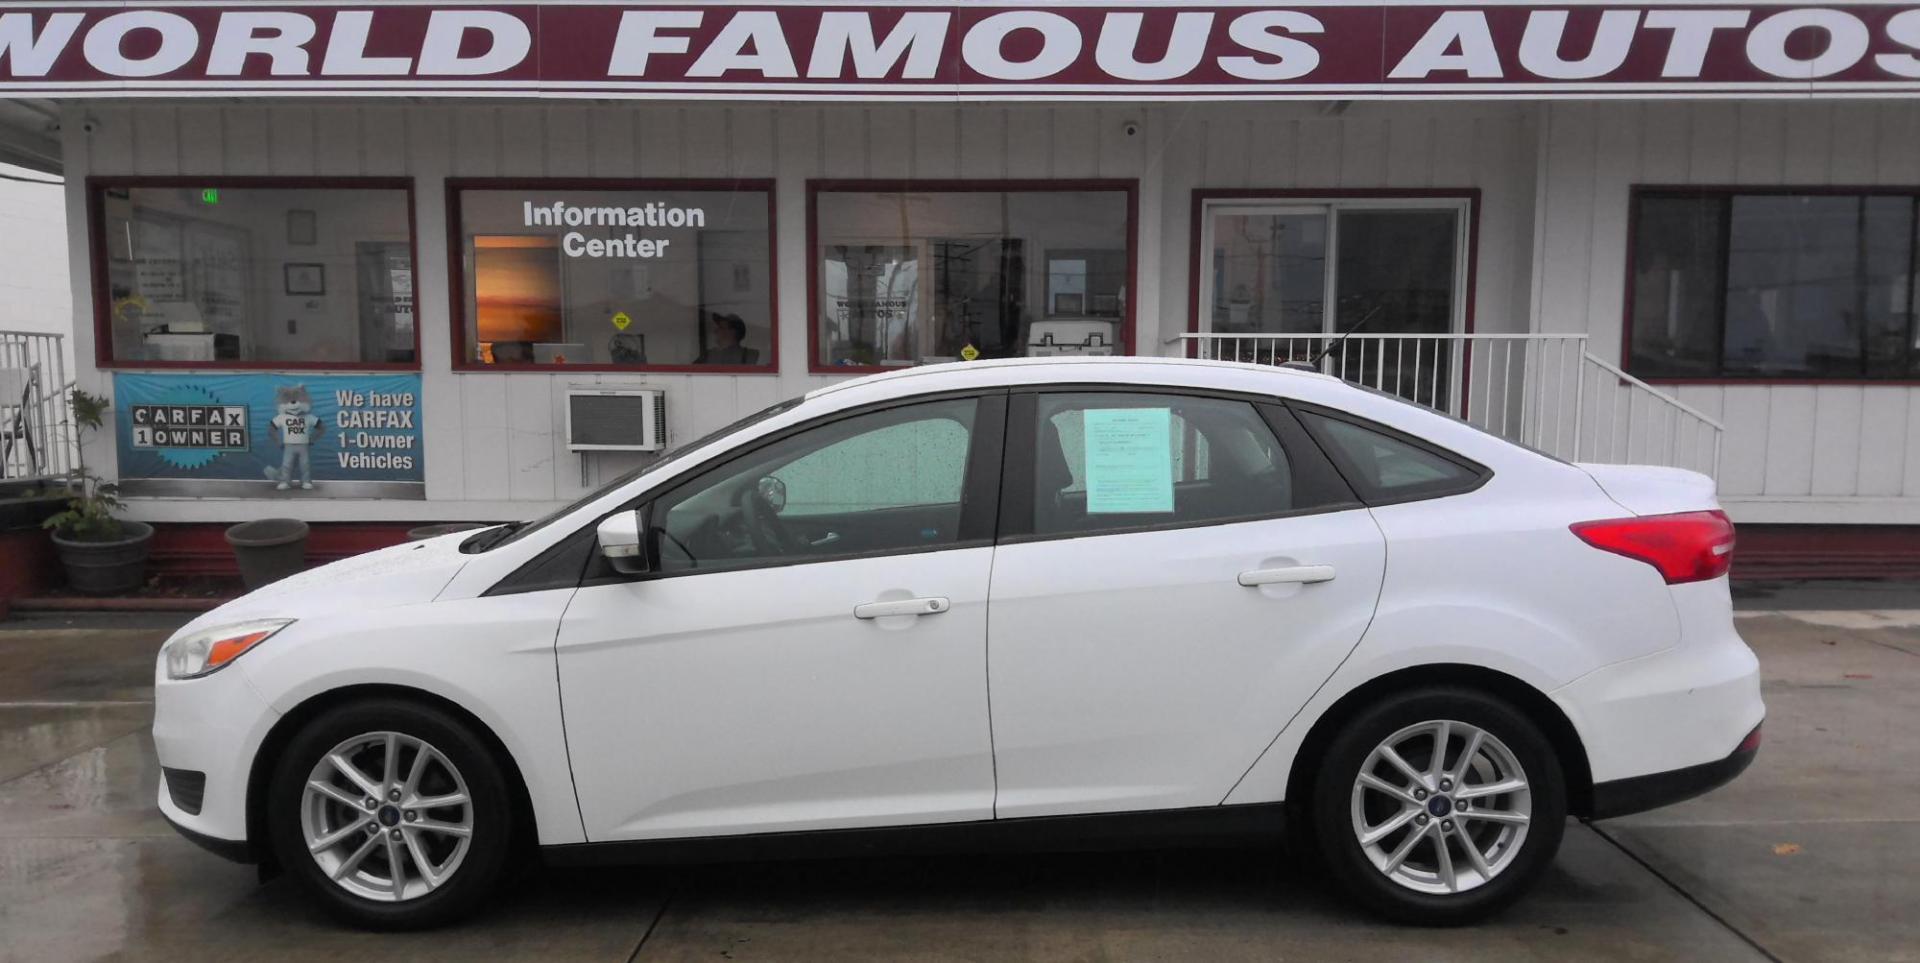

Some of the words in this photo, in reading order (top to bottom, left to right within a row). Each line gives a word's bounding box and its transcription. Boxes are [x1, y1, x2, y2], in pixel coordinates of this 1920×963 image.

[607, 9, 1325, 80] FAMOUS
[523, 201, 705, 227] Information
[562, 232, 669, 258] Center
[336, 389, 364, 407] We
[369, 389, 414, 407] have
[135, 408, 241, 426] CARFAX
[285, 418, 305, 426] CAR
[336, 410, 413, 428] CARFAX
[287, 427, 305, 435] FOX
[338, 431, 415, 448] 1-Owner
[337, 452, 413, 469] Vehicles
